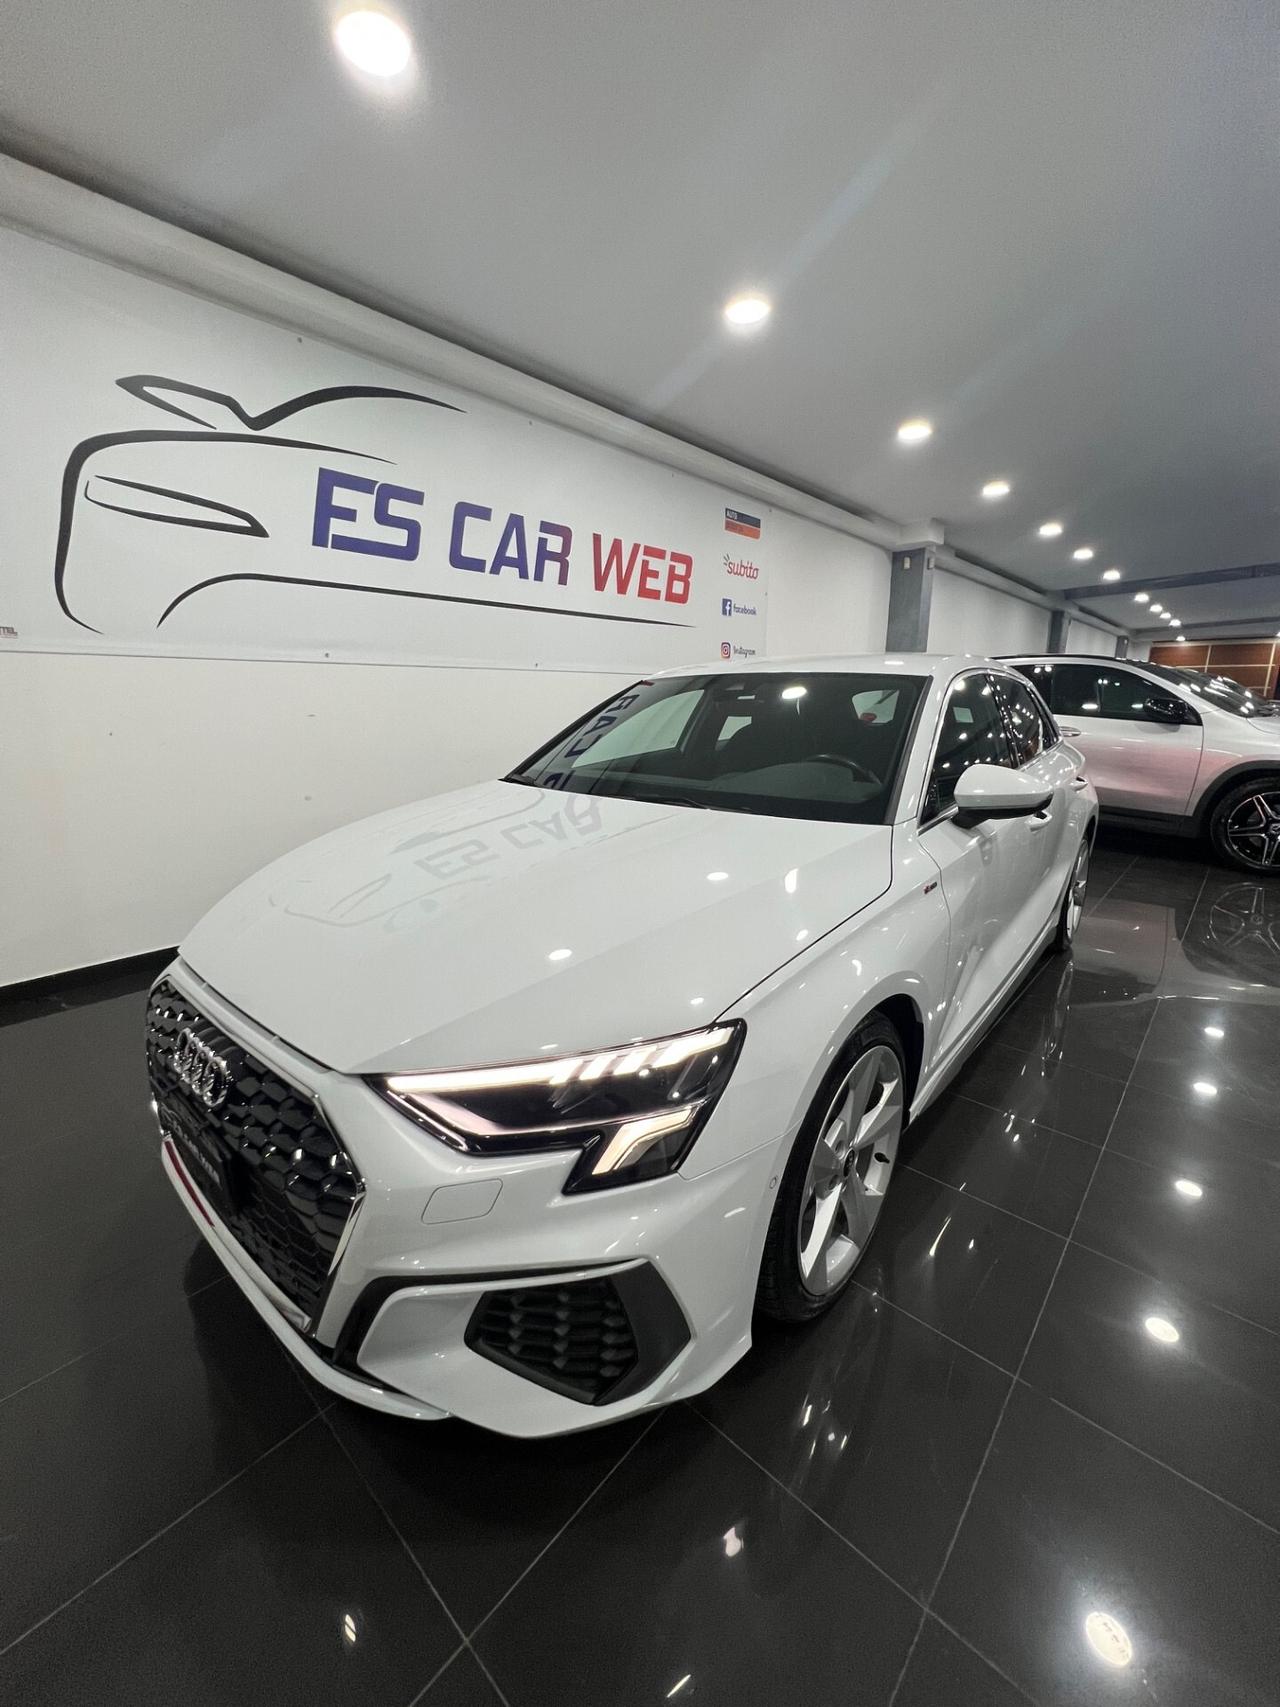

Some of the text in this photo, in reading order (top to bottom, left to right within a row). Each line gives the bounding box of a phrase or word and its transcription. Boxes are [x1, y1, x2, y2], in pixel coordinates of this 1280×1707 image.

[312, 467, 694, 605] ES CAR WEB
[727, 559, 759, 580] subito
[733, 603, 757, 616] facebook
